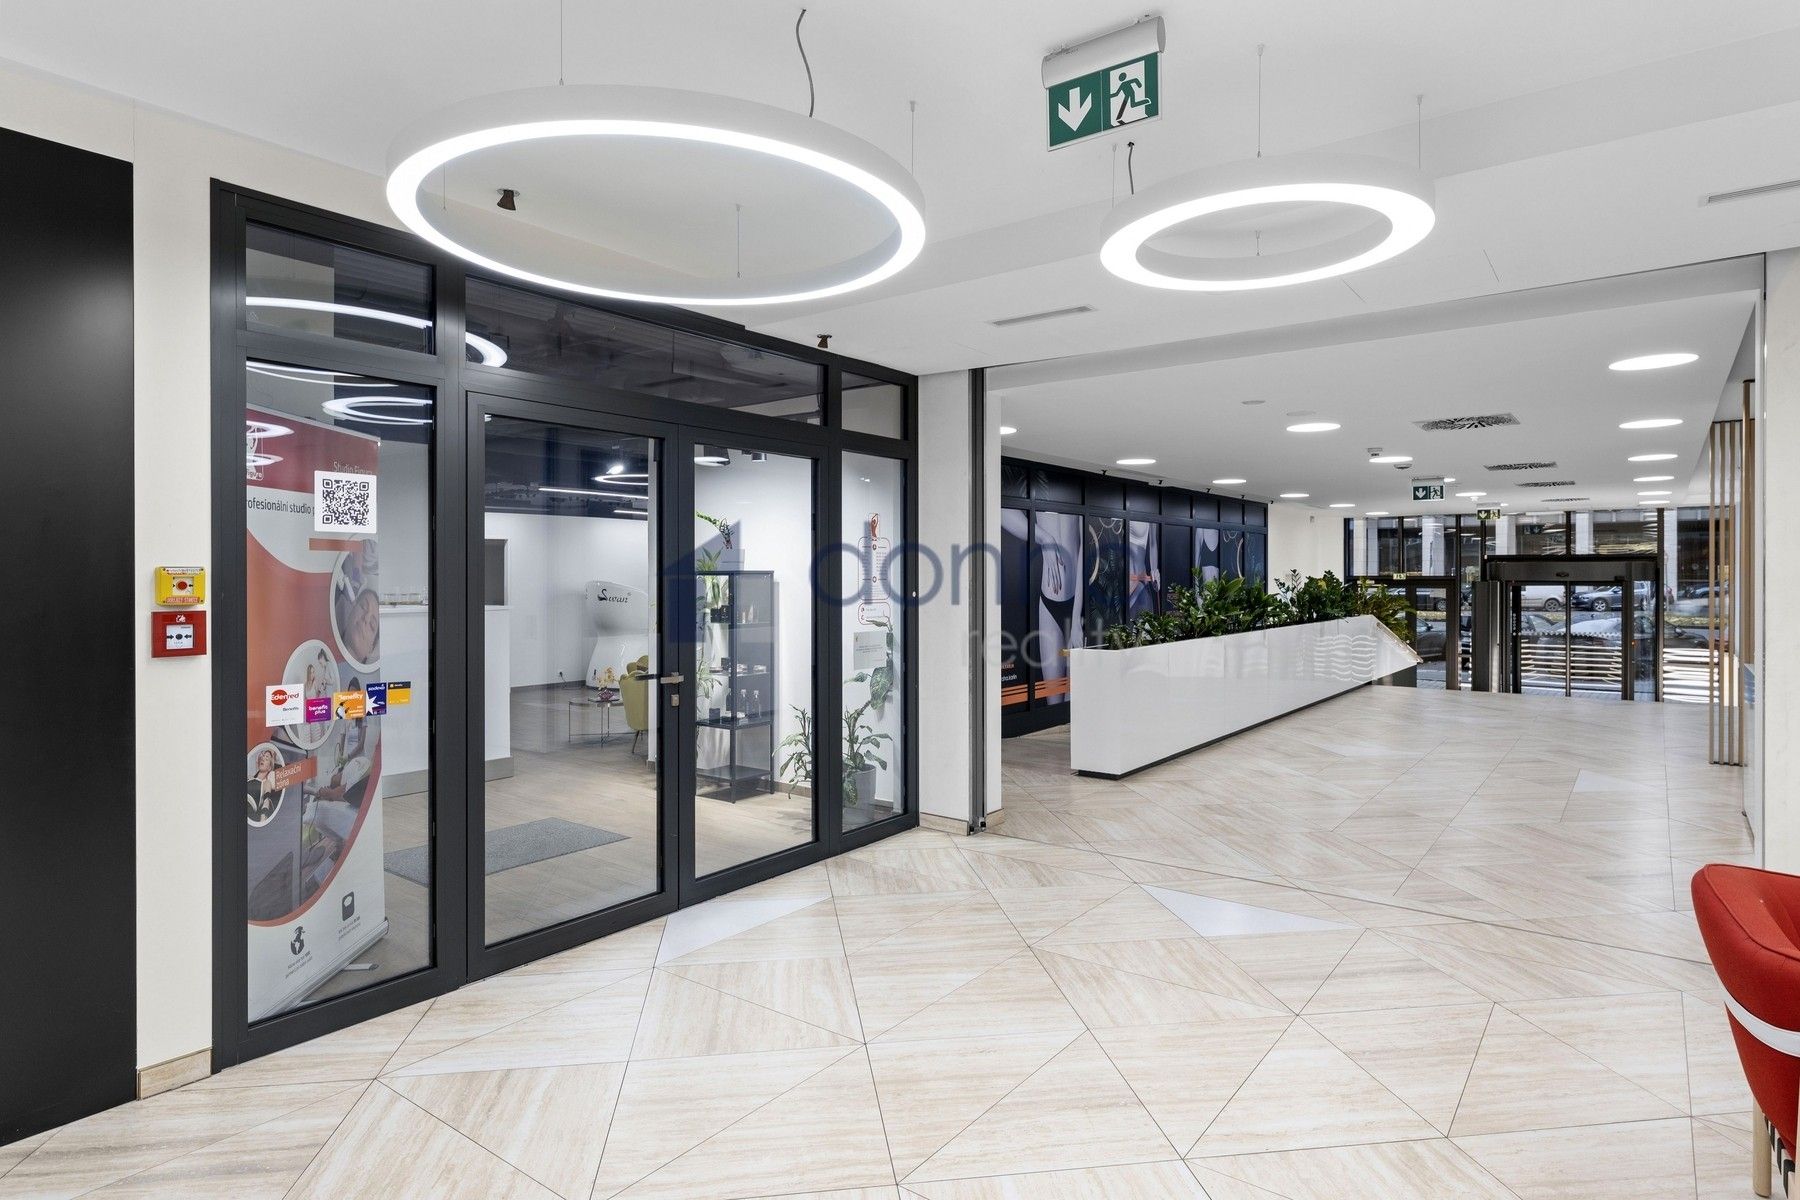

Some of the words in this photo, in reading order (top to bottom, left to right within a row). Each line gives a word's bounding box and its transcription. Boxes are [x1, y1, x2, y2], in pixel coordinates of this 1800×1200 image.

[247, 497, 289, 512] ofesionální
[289, 503, 312, 515] studio
[271, 693, 300, 701] Edenred
